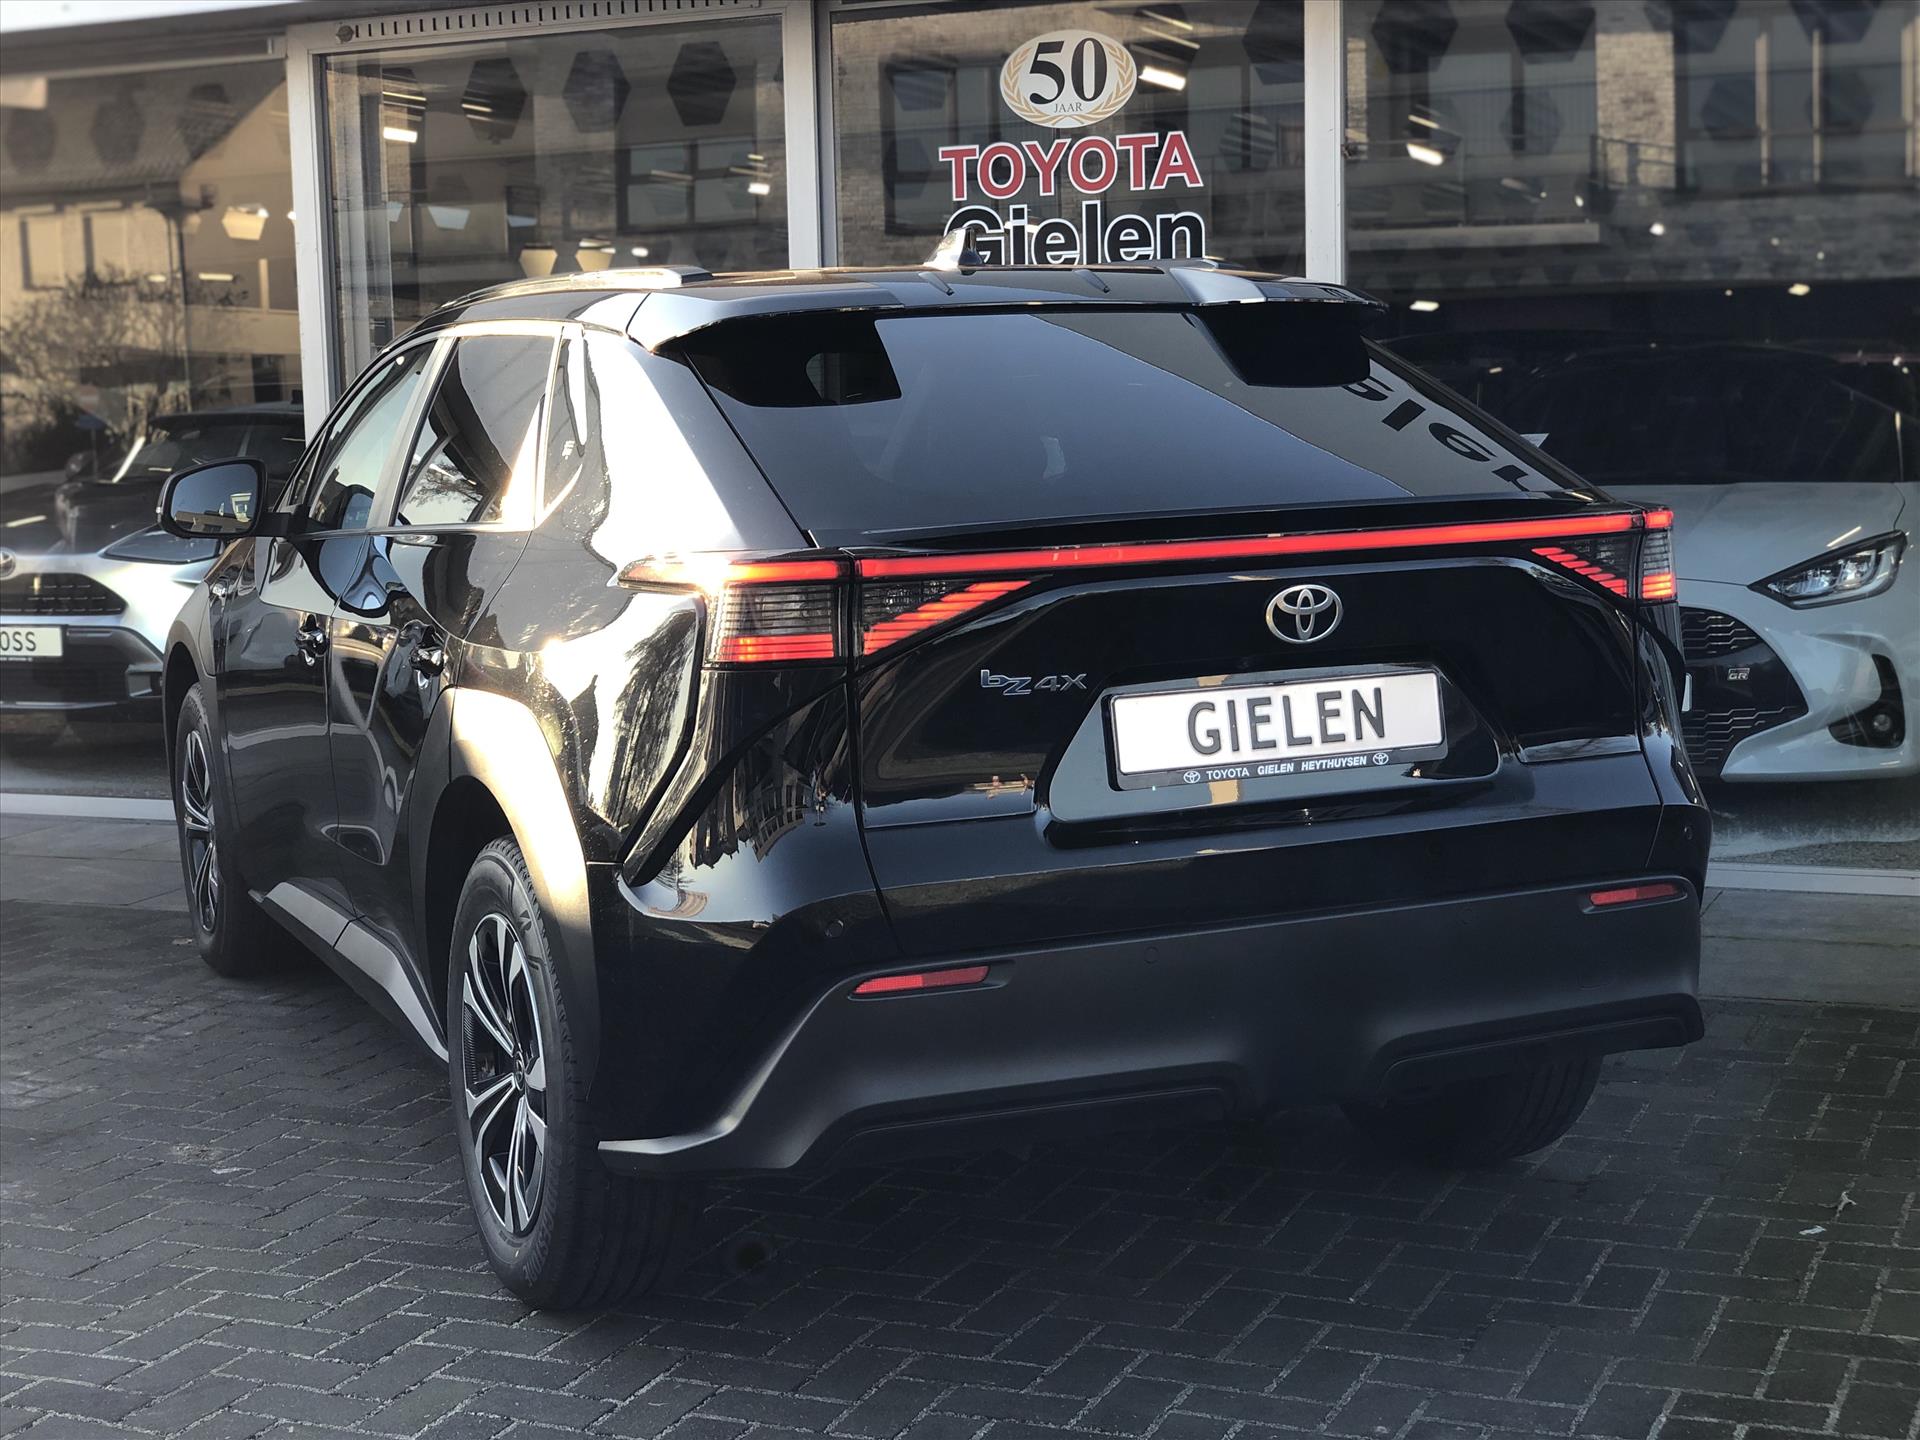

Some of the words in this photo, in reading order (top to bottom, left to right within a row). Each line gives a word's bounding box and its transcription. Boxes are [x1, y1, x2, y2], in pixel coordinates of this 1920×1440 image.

[1028, 37, 1108, 105] 50
[1053, 101, 1083, 113] JAAR
[939, 131, 1204, 201] TOYOTA
[1187, 687, 1385, 755] GIELEN
[1205, 767, 1250, 780] TOYOTA
[1257, 763, 1295, 775] GIELEN
[1301, 755, 1368, 771] HEYTHUYSEN
